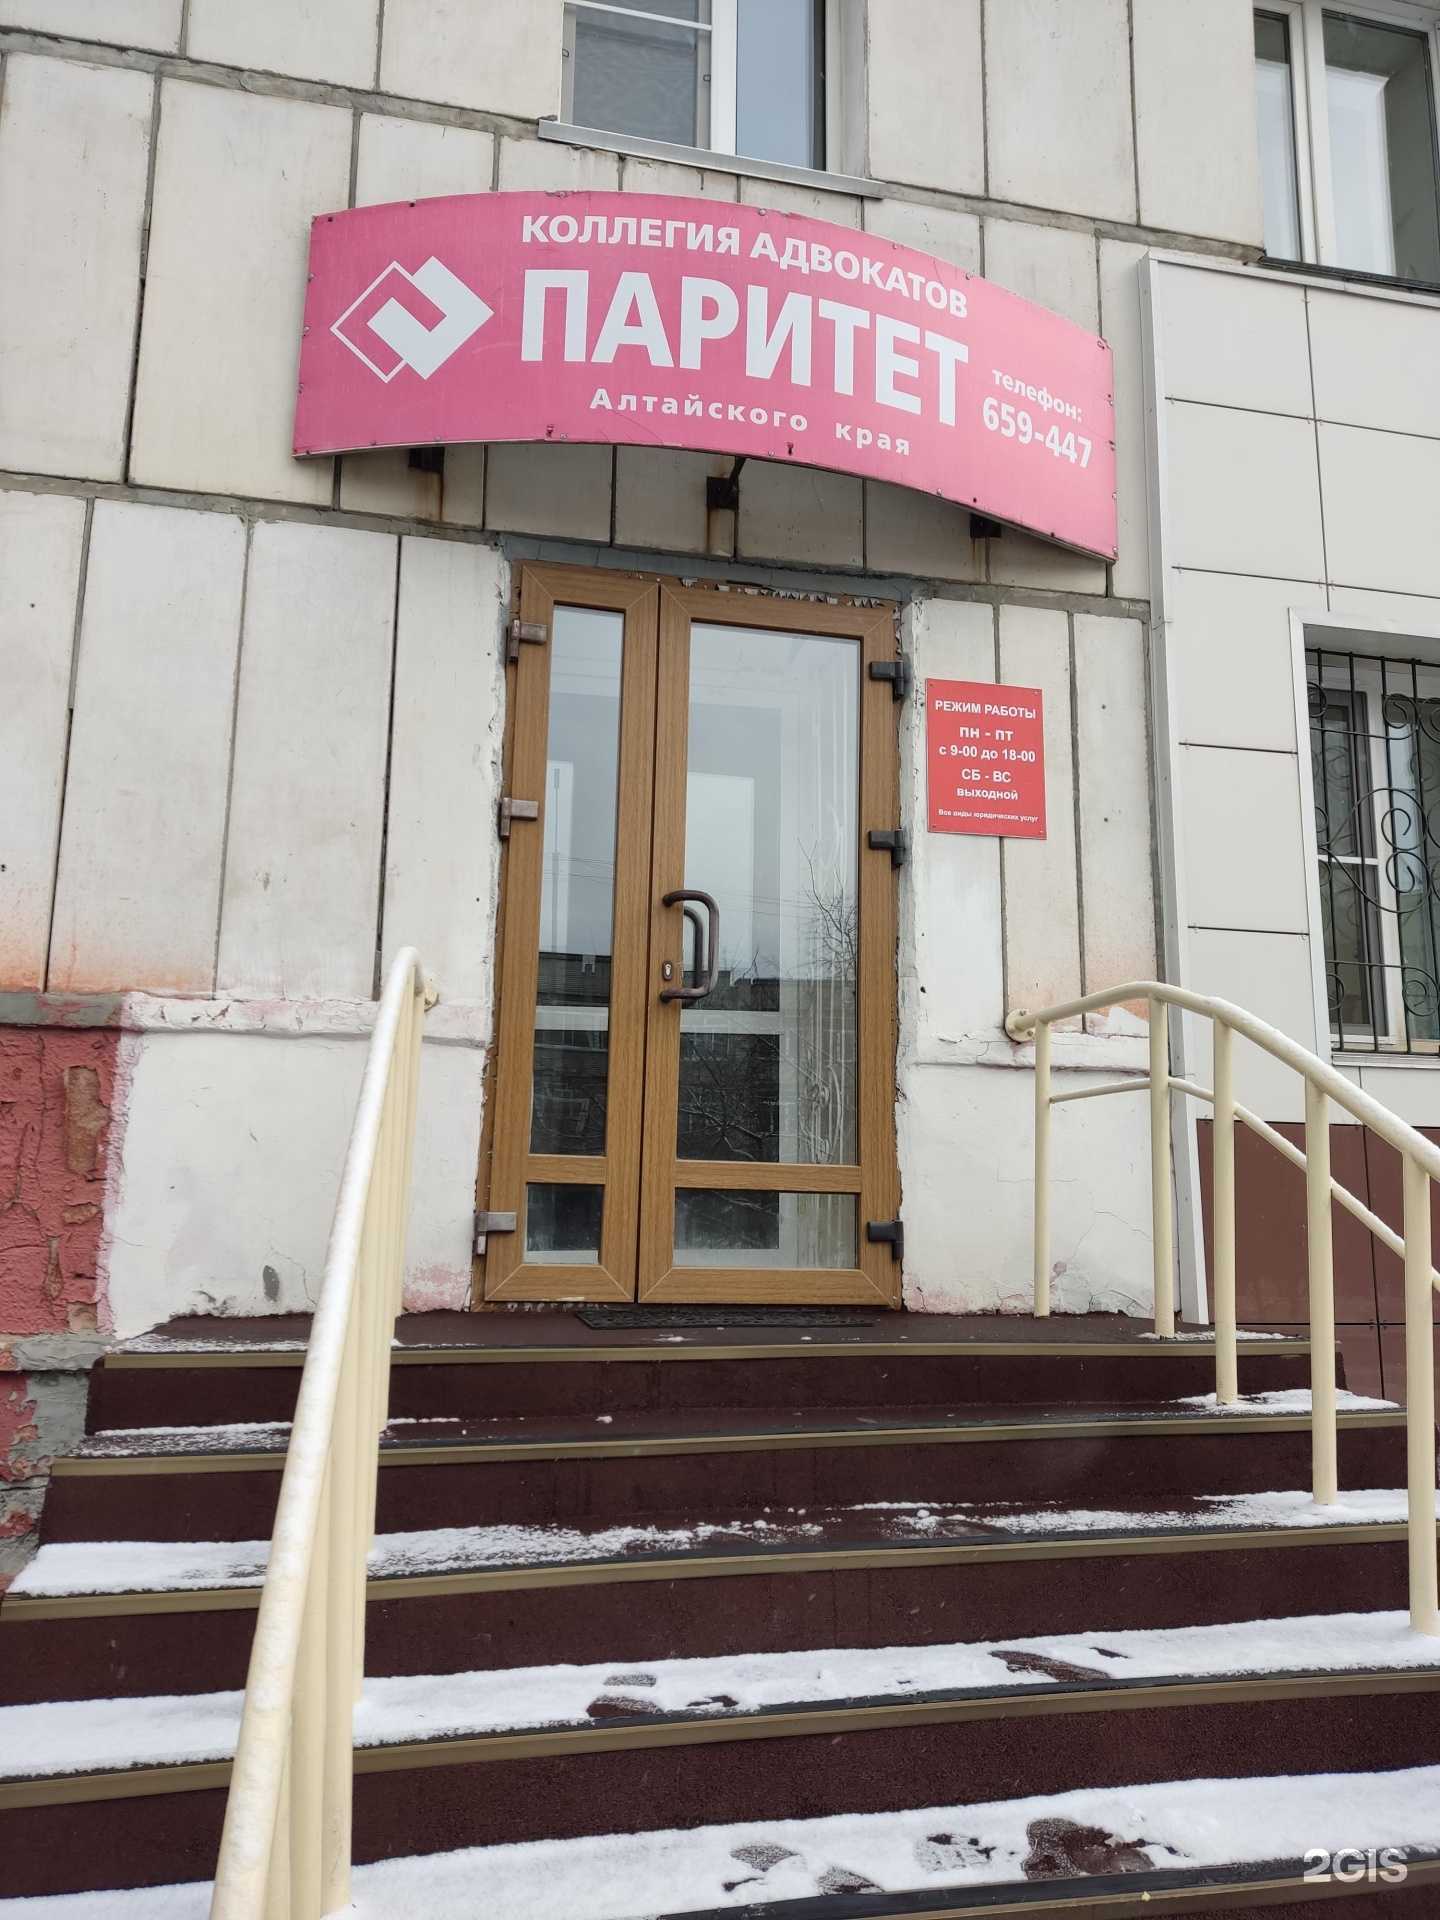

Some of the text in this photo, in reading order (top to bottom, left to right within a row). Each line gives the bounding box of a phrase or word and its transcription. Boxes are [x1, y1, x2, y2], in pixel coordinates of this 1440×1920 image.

[522, 215, 968, 319] КОЛЛЕГИЯ АДВОКАТОВ
[520, 269, 969, 427] ПАРИТЕТ
[589, 388, 910, 456] Алтайского края
[991, 369, 1083, 423] телефон:
[982, 396, 1093, 468] 659-447
[935, 700, 1036, 719] РЕЖИМ РАБОТЫ
[938, 744, 1036, 762] с 9-00 до 18-00
[961, 768, 981, 781] СБ
[992, 770, 1012, 783] ВС
[938, 808, 952, 816] Все
[953, 810, 972, 818] виды
[1019, 815, 1039, 823] услуг
